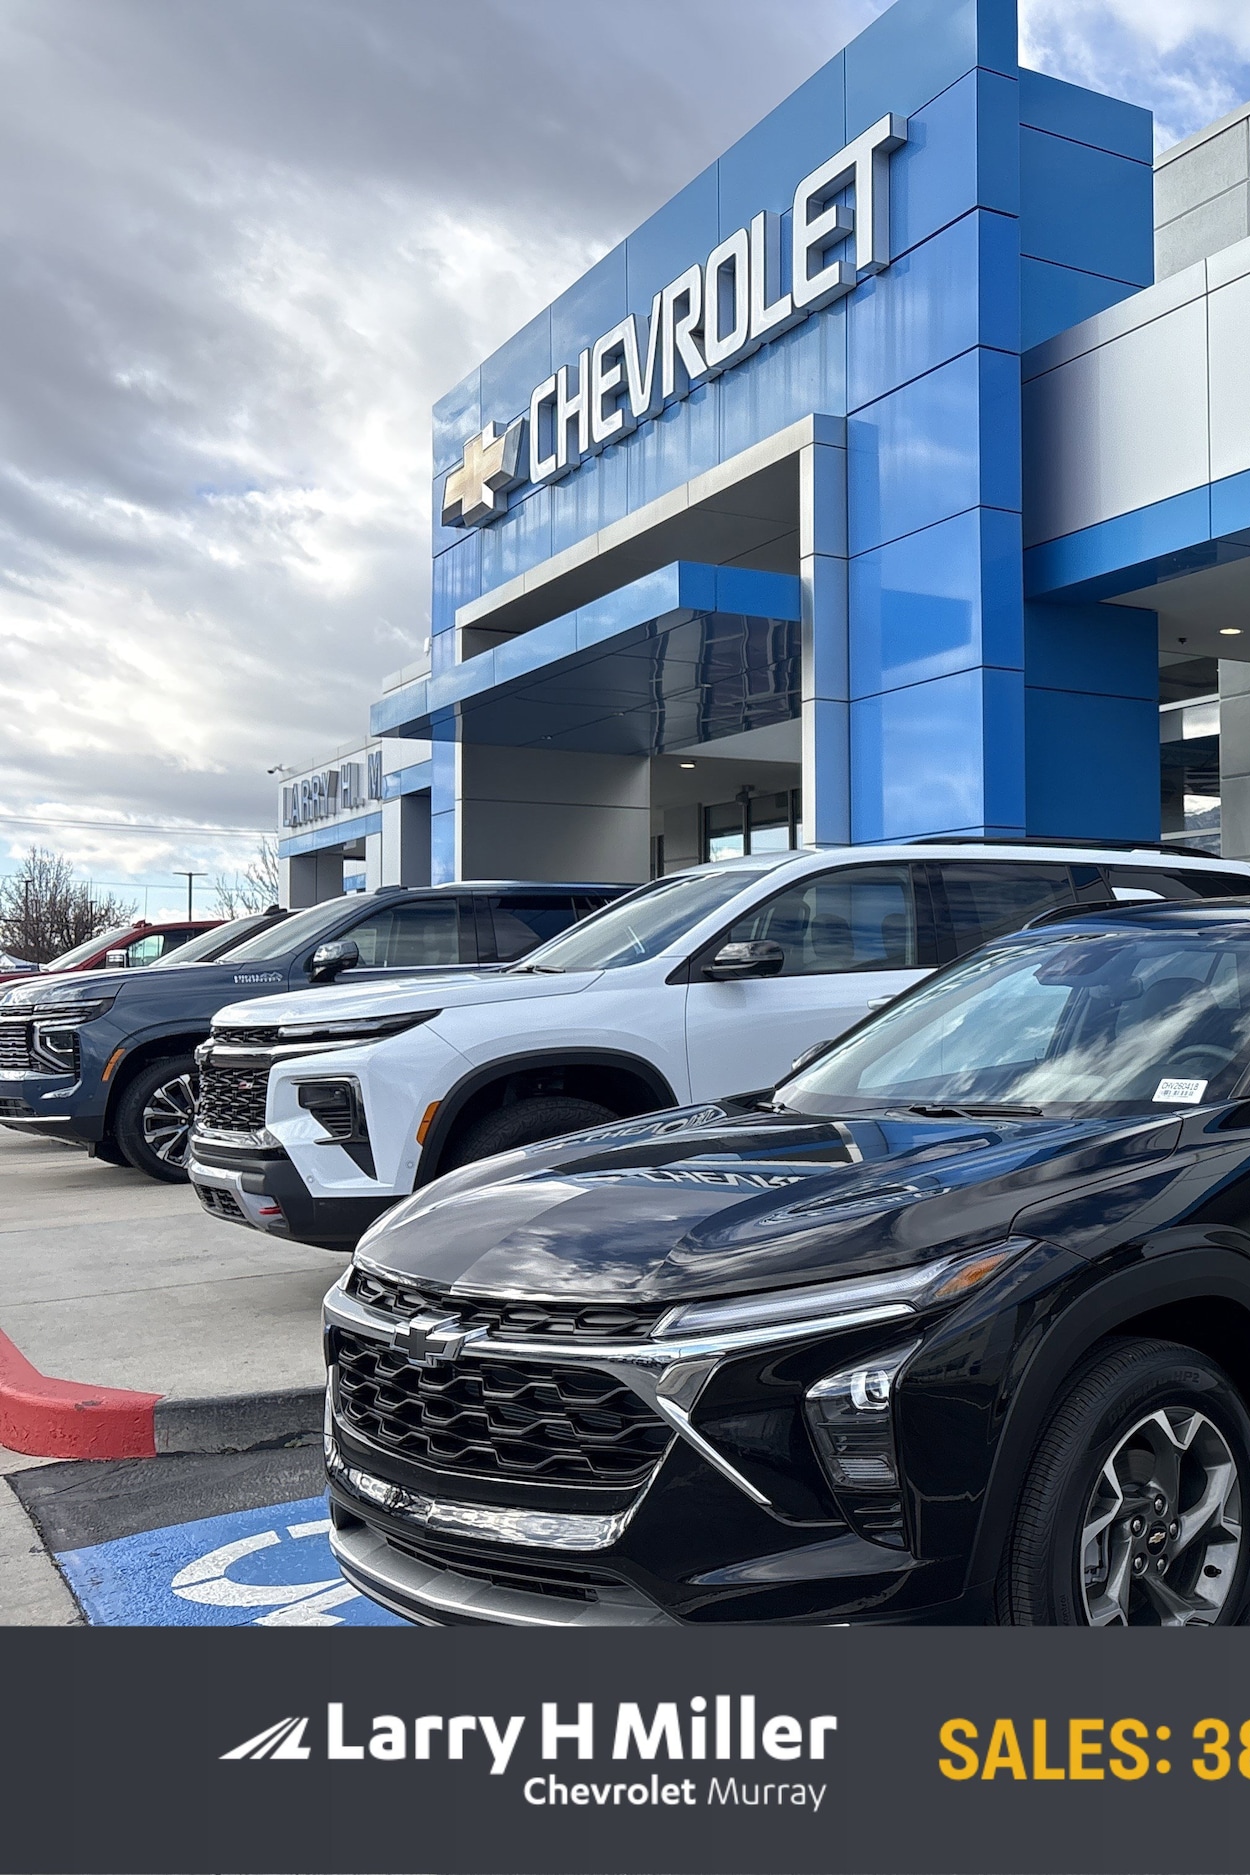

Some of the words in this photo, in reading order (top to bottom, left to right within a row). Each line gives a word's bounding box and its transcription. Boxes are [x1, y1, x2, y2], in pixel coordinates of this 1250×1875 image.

[529, 112, 907, 486] CHEVROLET
[283, 770, 339, 827] LARRY
[1174, 1370, 1200, 1384] HP2
